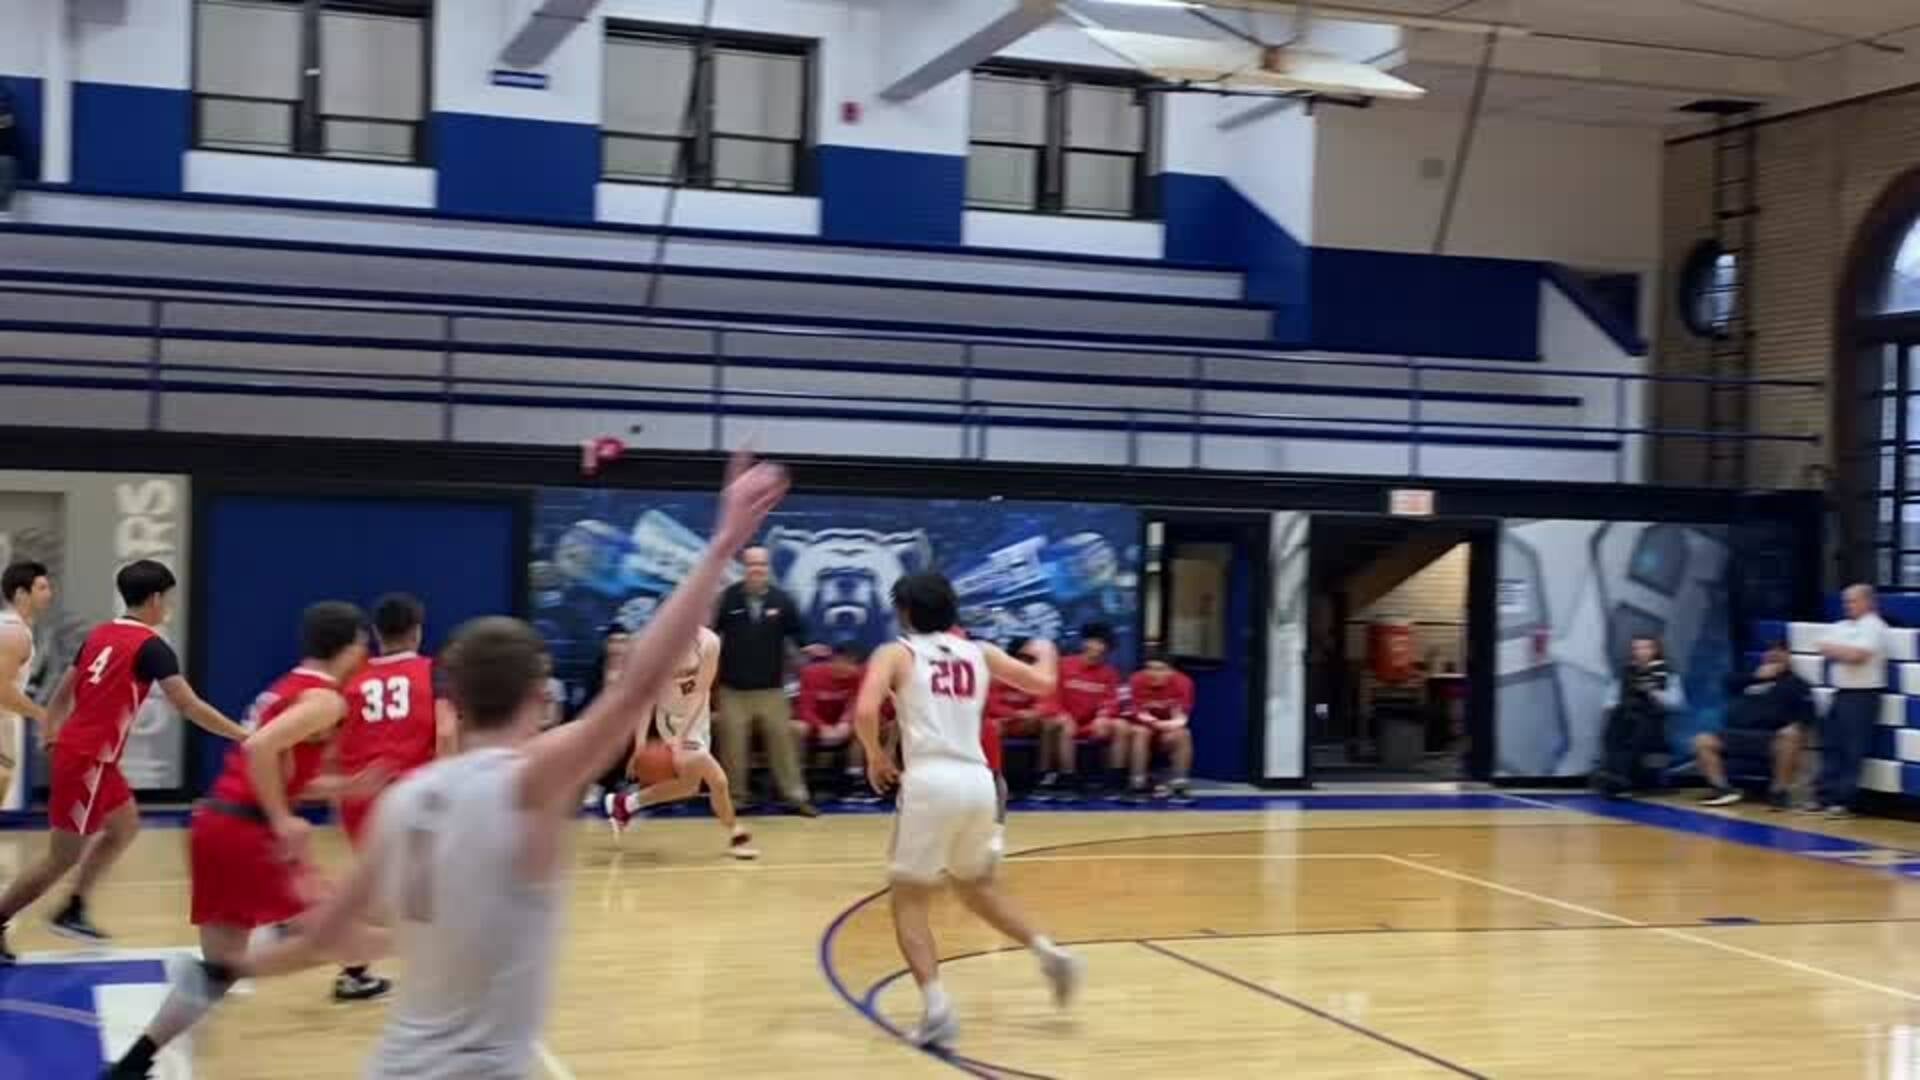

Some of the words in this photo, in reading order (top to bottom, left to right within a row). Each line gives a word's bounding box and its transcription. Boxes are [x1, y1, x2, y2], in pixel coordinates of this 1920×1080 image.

[87, 645, 112, 684] 4
[929, 659, 975, 698] 20
[360, 675, 409, 722] 33
